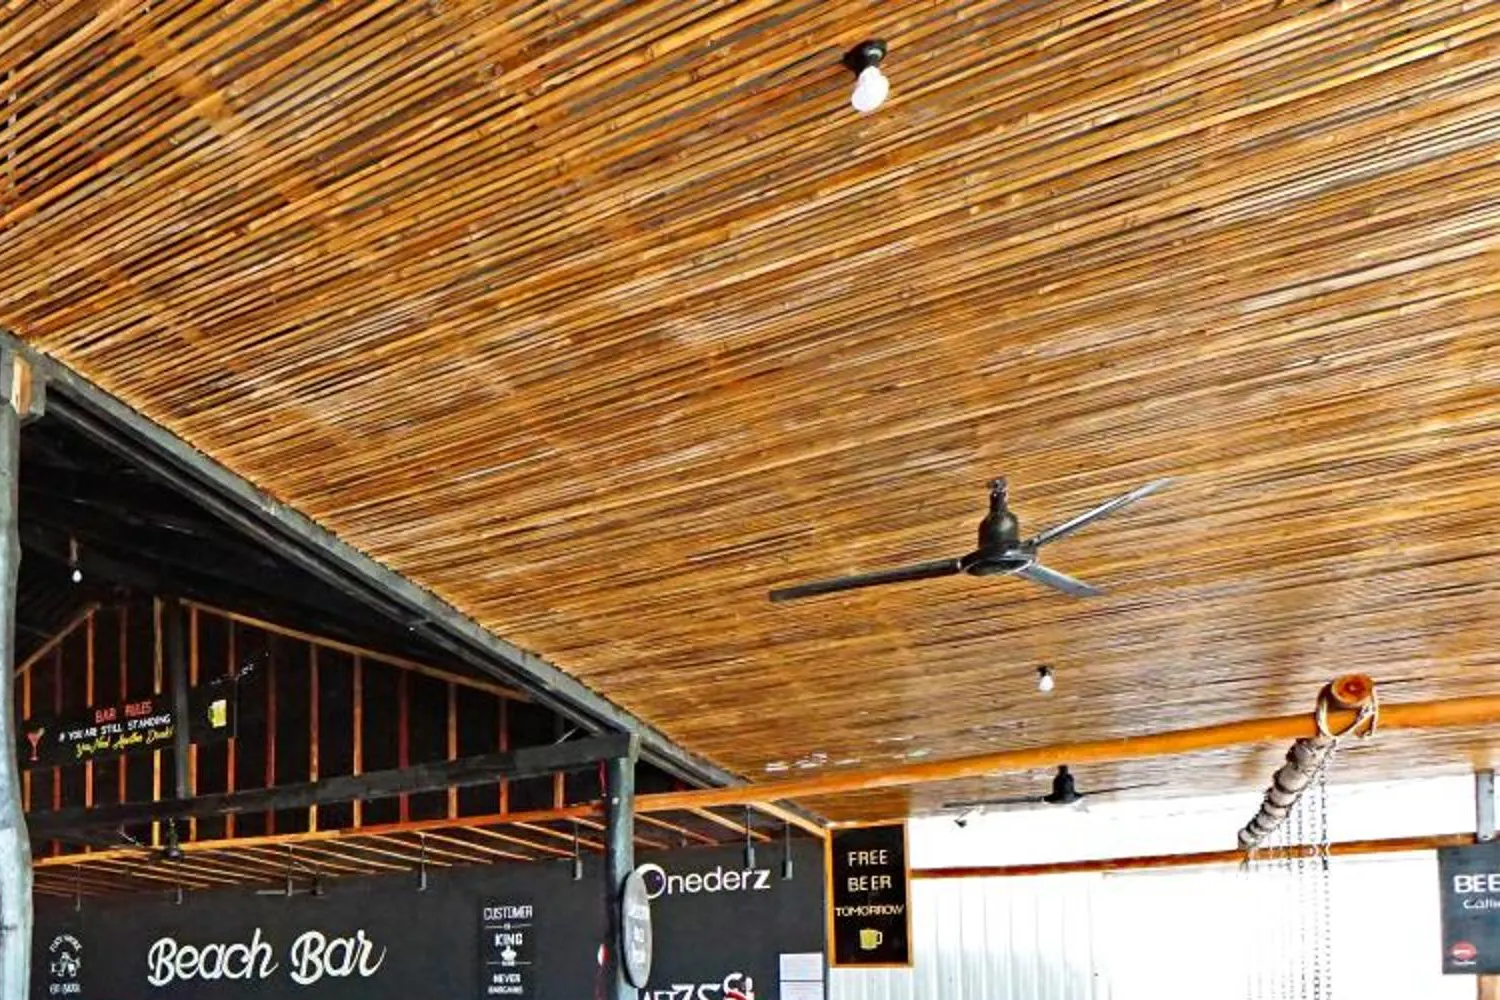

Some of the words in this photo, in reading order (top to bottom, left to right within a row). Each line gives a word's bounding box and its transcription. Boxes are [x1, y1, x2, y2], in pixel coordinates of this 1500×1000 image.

[95, 707, 116, 723] BAR
[68, 729, 83, 741] YOU
[85, 727, 98, 737] ARE
[101, 723, 123, 735] STILL
[127, 713, 171, 731] STANDING
[847, 849, 889, 867] FREE
[634, 862, 772, 899] Onederz
[847, 874, 892, 893] BEER
[483, 905, 533, 921] CUSTOMER
[835, 904, 905, 917] TOMORROW
[495, 932, 523, 947] KING
[147, 927, 279, 987] Beach
[290, 929, 387, 986] Bar
[493, 973, 521, 984] NEVER
